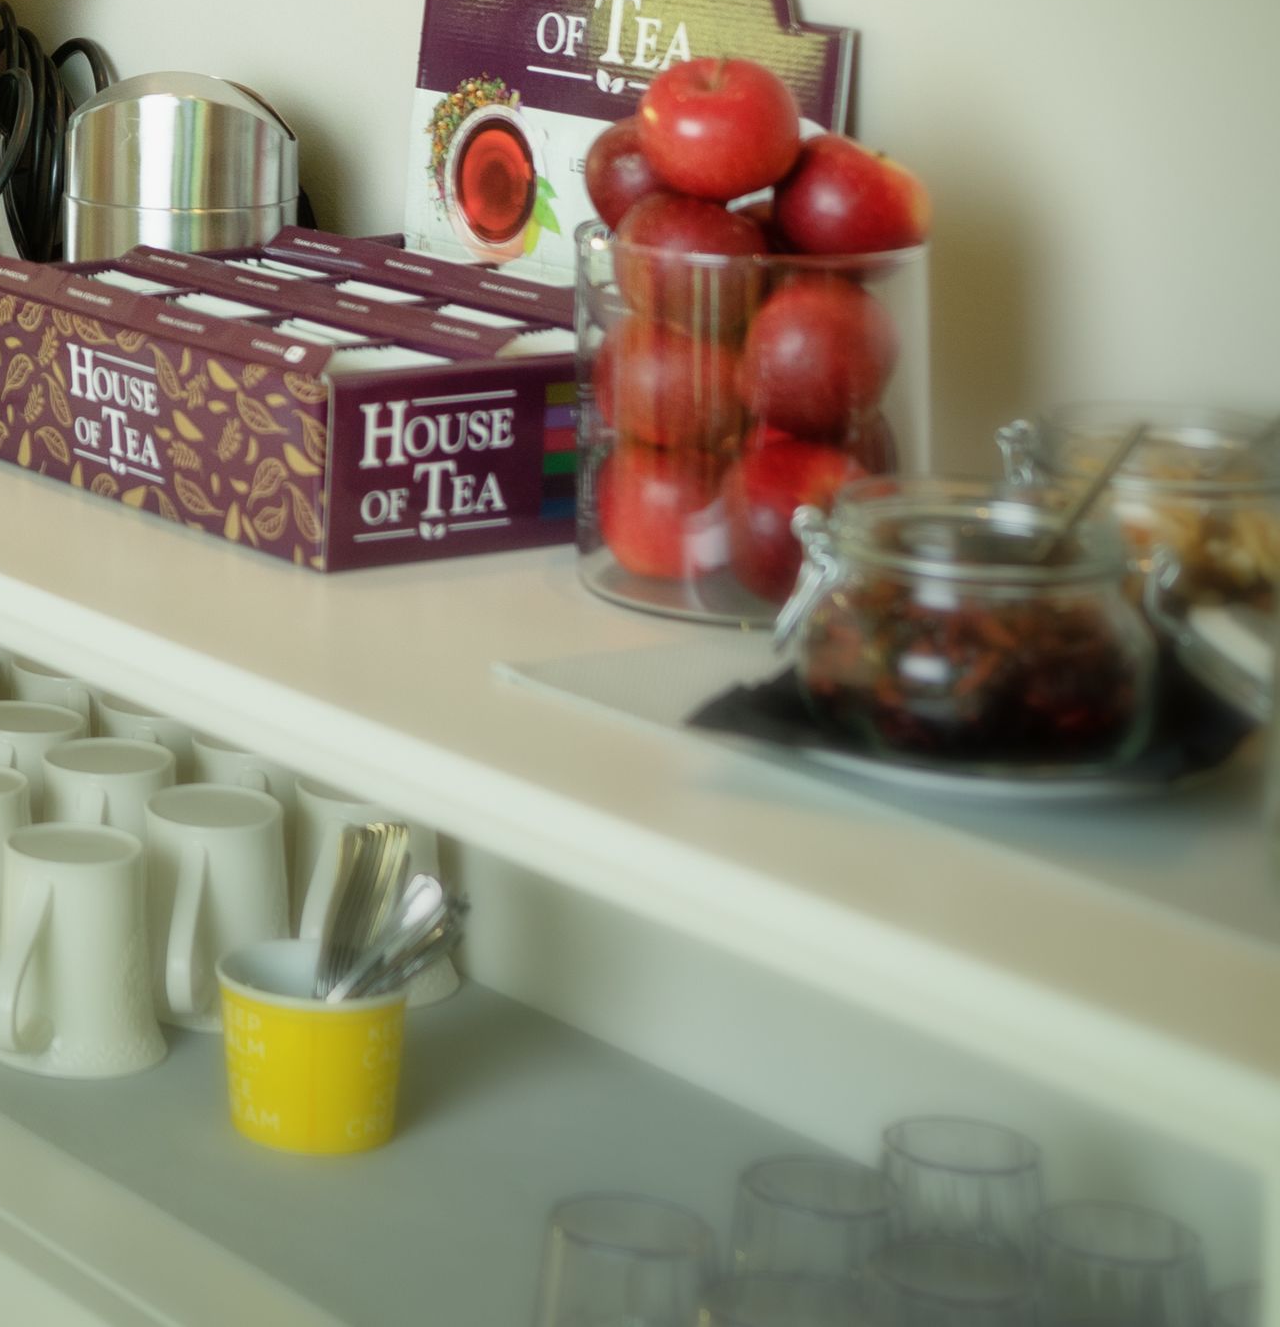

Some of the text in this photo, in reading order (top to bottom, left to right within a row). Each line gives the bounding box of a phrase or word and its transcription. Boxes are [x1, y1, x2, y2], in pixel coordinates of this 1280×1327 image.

[536, 11, 587, 57] OF
[66, 342, 160, 416] HOUSE
[74, 405, 162, 470] OF TEA
[358, 399, 516, 470] HOUSE
[360, 459, 508, 526] OF TEA
